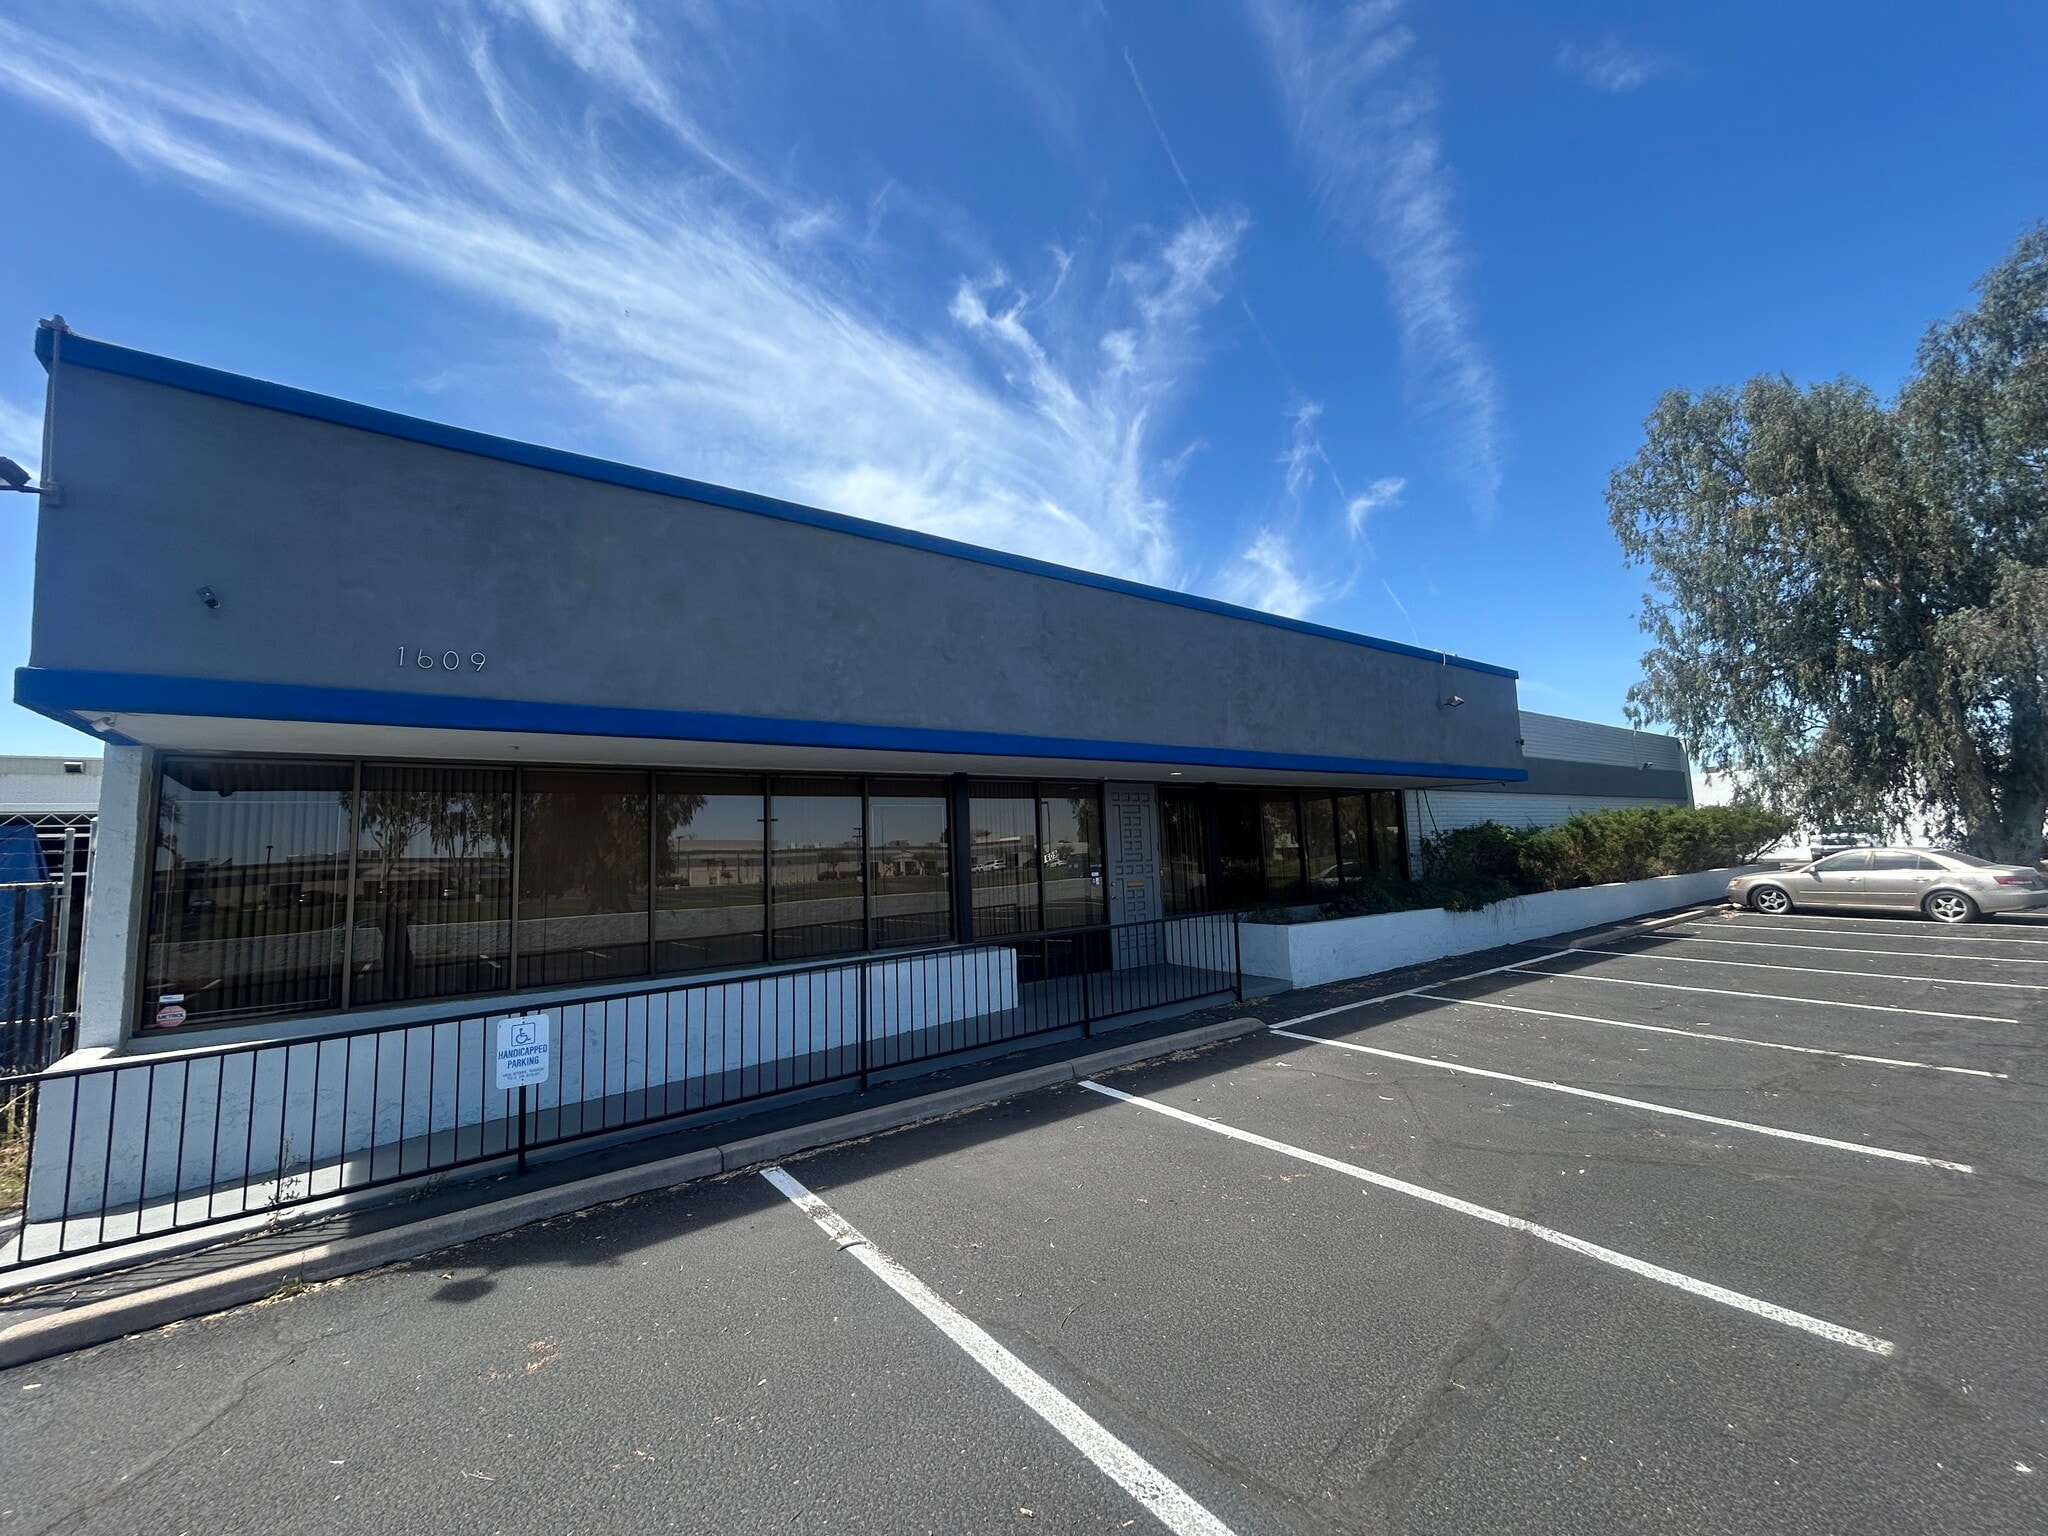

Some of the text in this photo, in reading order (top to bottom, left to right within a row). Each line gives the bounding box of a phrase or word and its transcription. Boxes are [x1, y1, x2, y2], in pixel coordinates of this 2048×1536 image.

[398, 646, 486, 672] 1609
[498, 1044, 548, 1060] HANDICAPPED
[507, 1056, 540, 1069] PARKING
